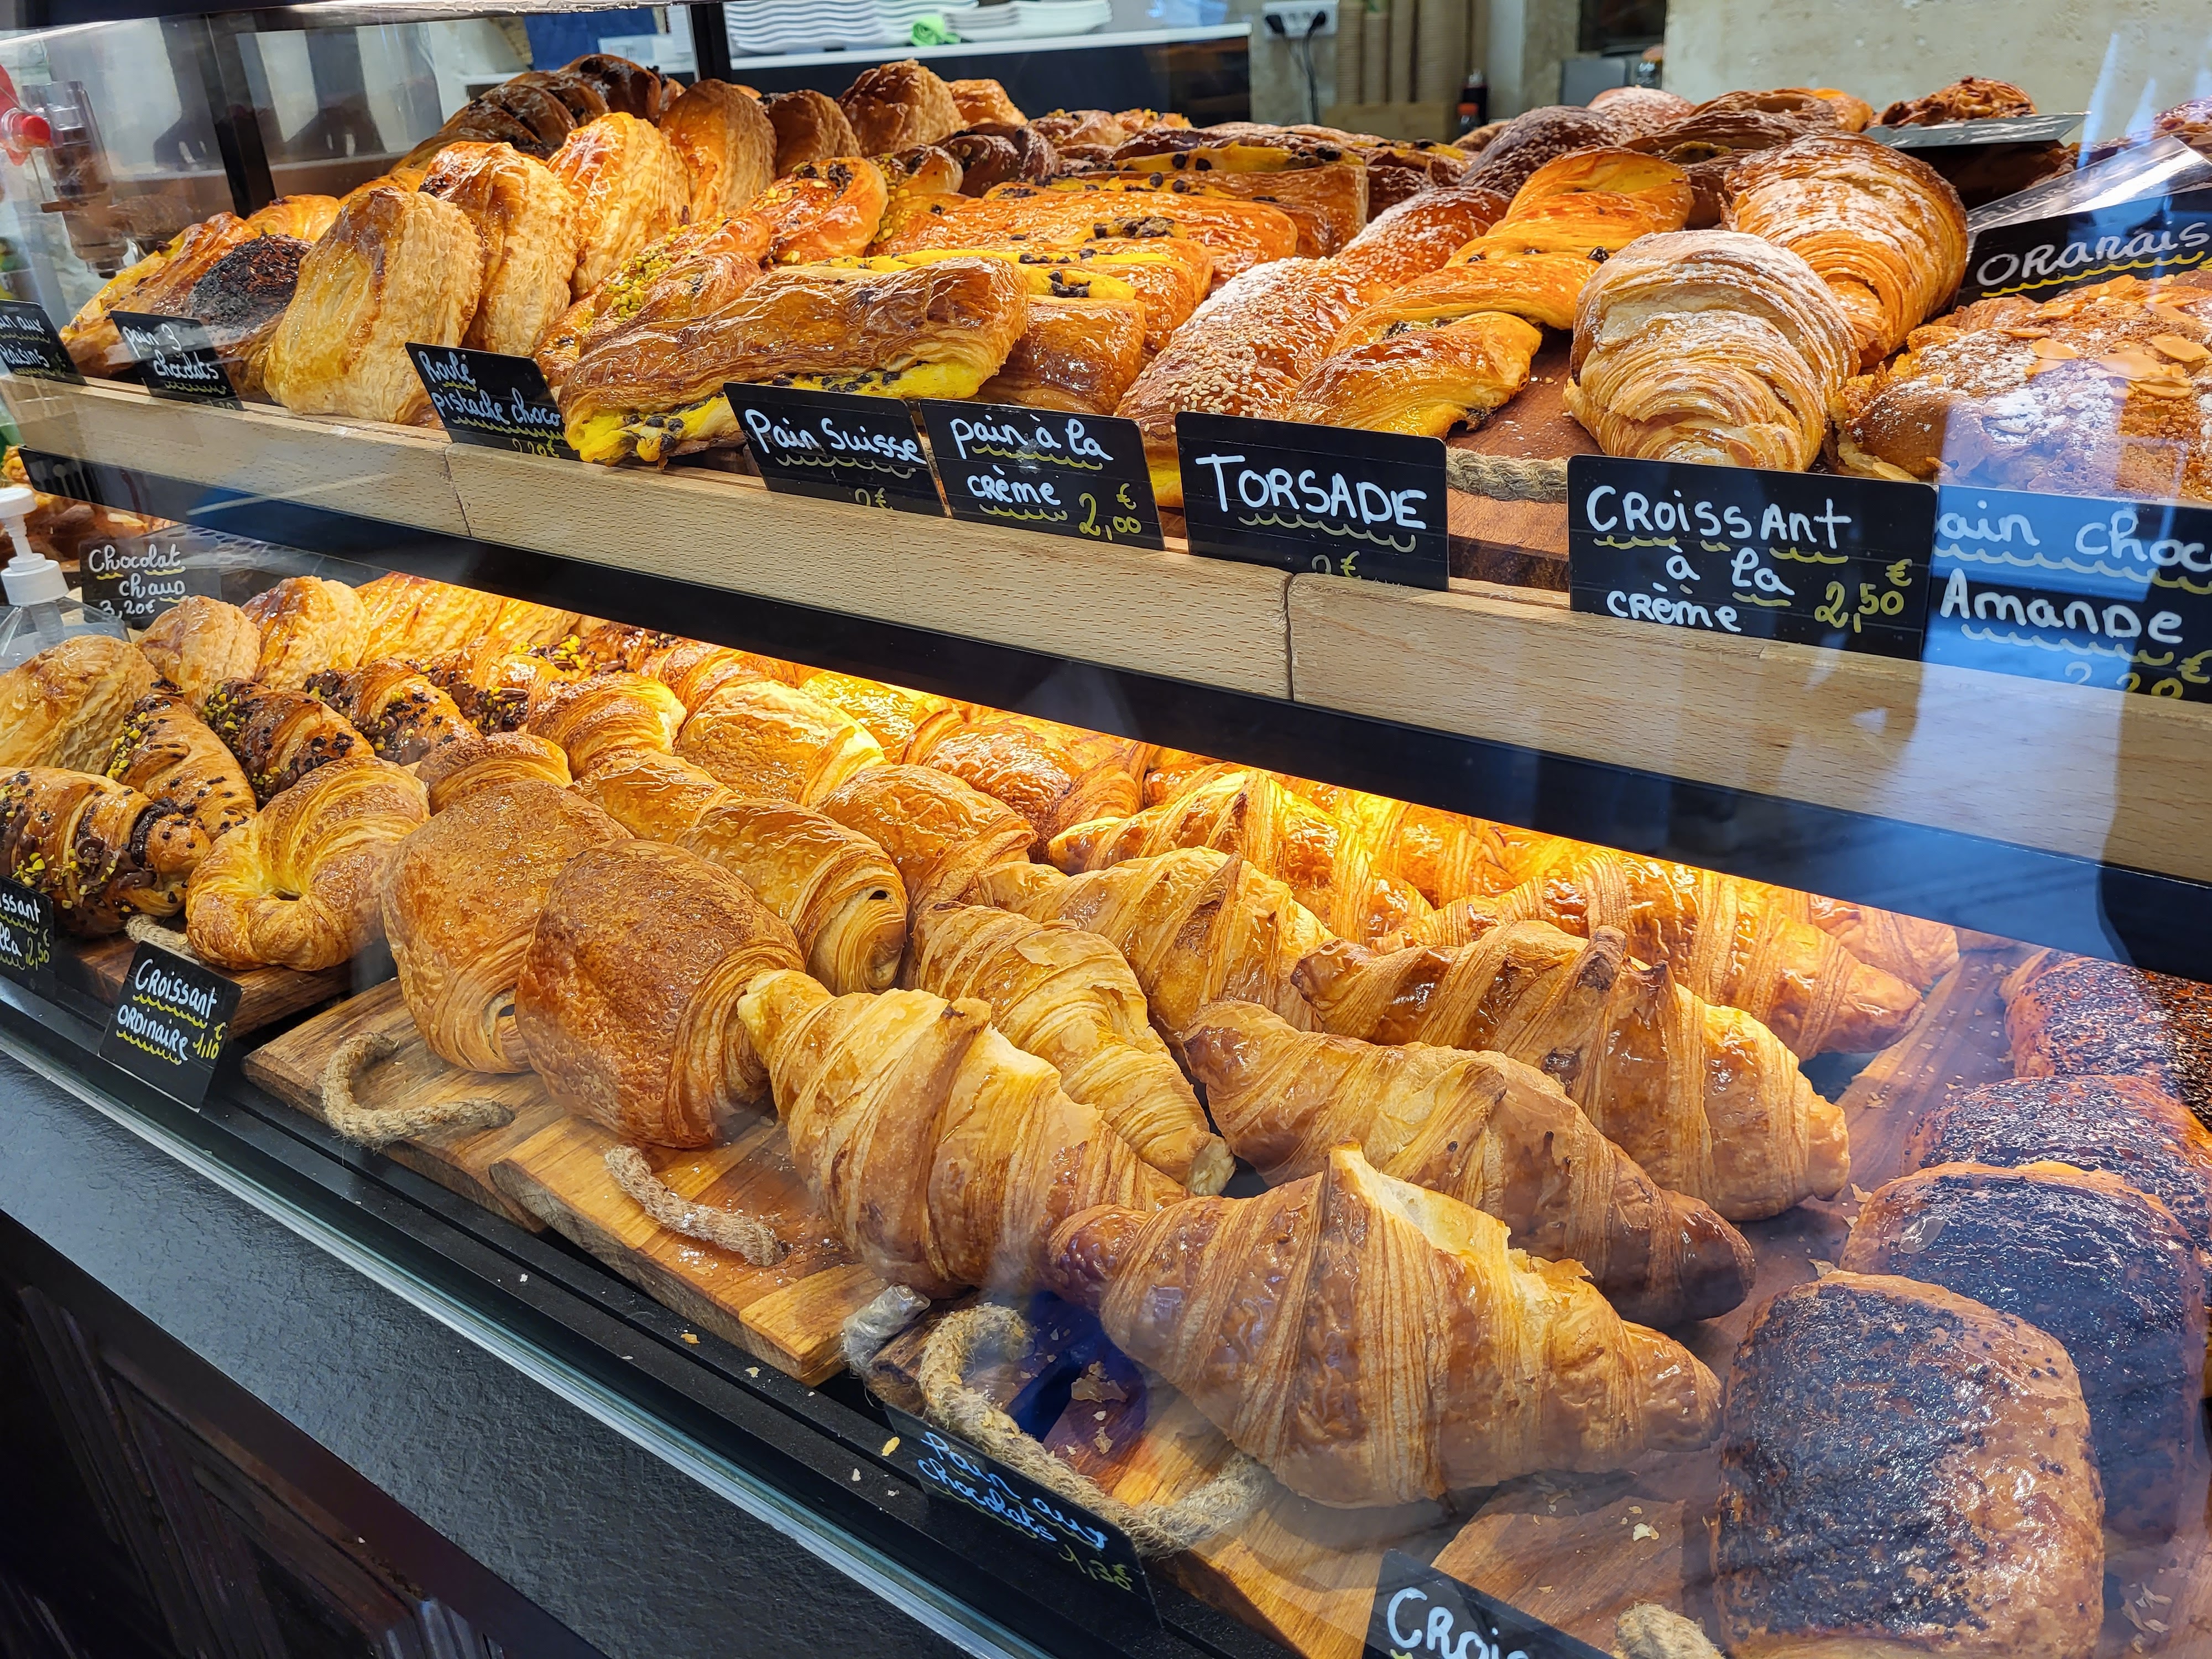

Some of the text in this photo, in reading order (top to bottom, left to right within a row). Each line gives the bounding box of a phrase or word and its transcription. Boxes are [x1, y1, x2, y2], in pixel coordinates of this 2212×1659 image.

[161, 323, 182, 351] 3
[511, 387, 561, 427] choco
[745, 409, 927, 465] Pain Suisse
[1030, 414, 1062, 449] à
[1065, 418, 1114, 461] la
[1195, 453, 1427, 529] TORSADE
[88, 544, 181, 572] Chocolat
[1666, 544, 1795, 596] à la
[1032, 1498, 1109, 1550] aux
